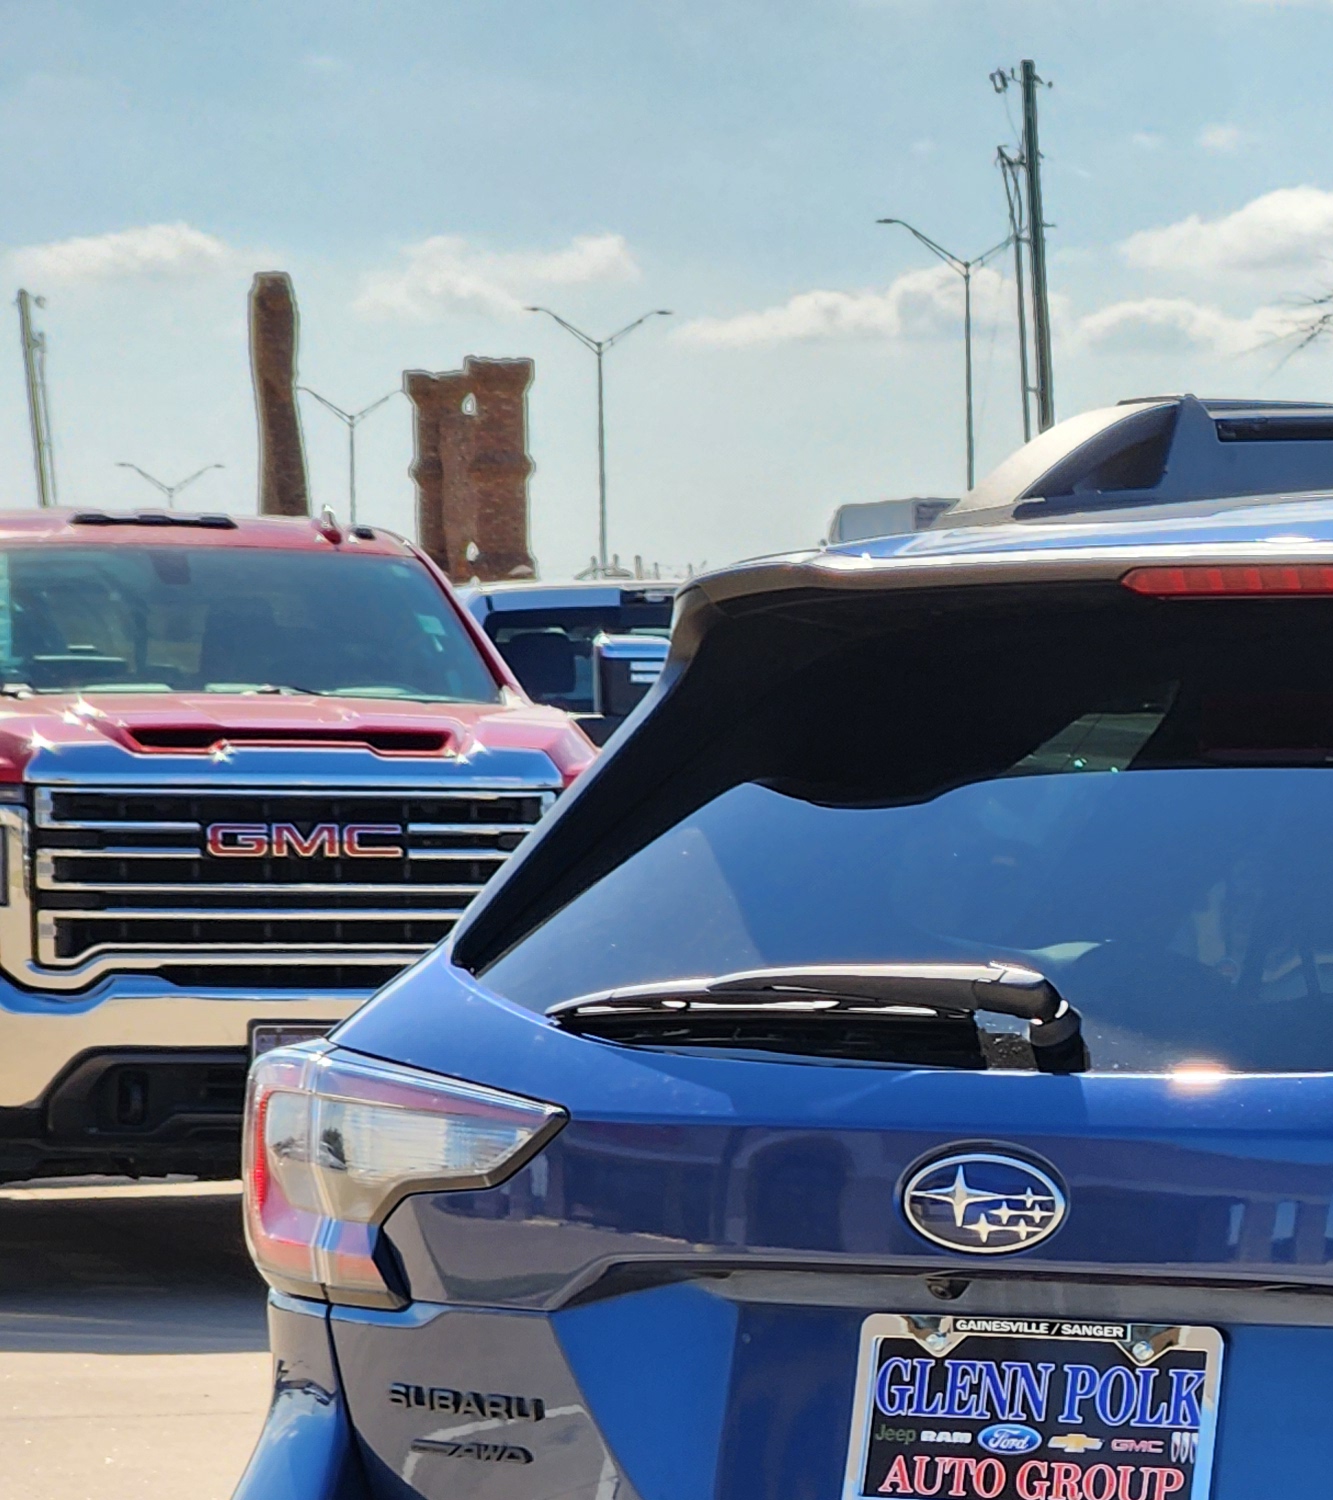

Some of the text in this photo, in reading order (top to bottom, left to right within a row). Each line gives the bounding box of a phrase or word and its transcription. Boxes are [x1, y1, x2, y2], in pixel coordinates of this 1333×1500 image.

[205, 823, 405, 858] GMC
[956, 1319, 1049, 1334] GAINESVILLE
[1061, 1323, 1123, 1338] SANGER
[389, 1382, 545, 1422] SUBARU
[875, 1357, 1205, 1428] GLENN POLK
[875, 1424, 1164, 1454] Jeep RAM Ford GMC
[878, 1455, 1006, 1498] AUTO
